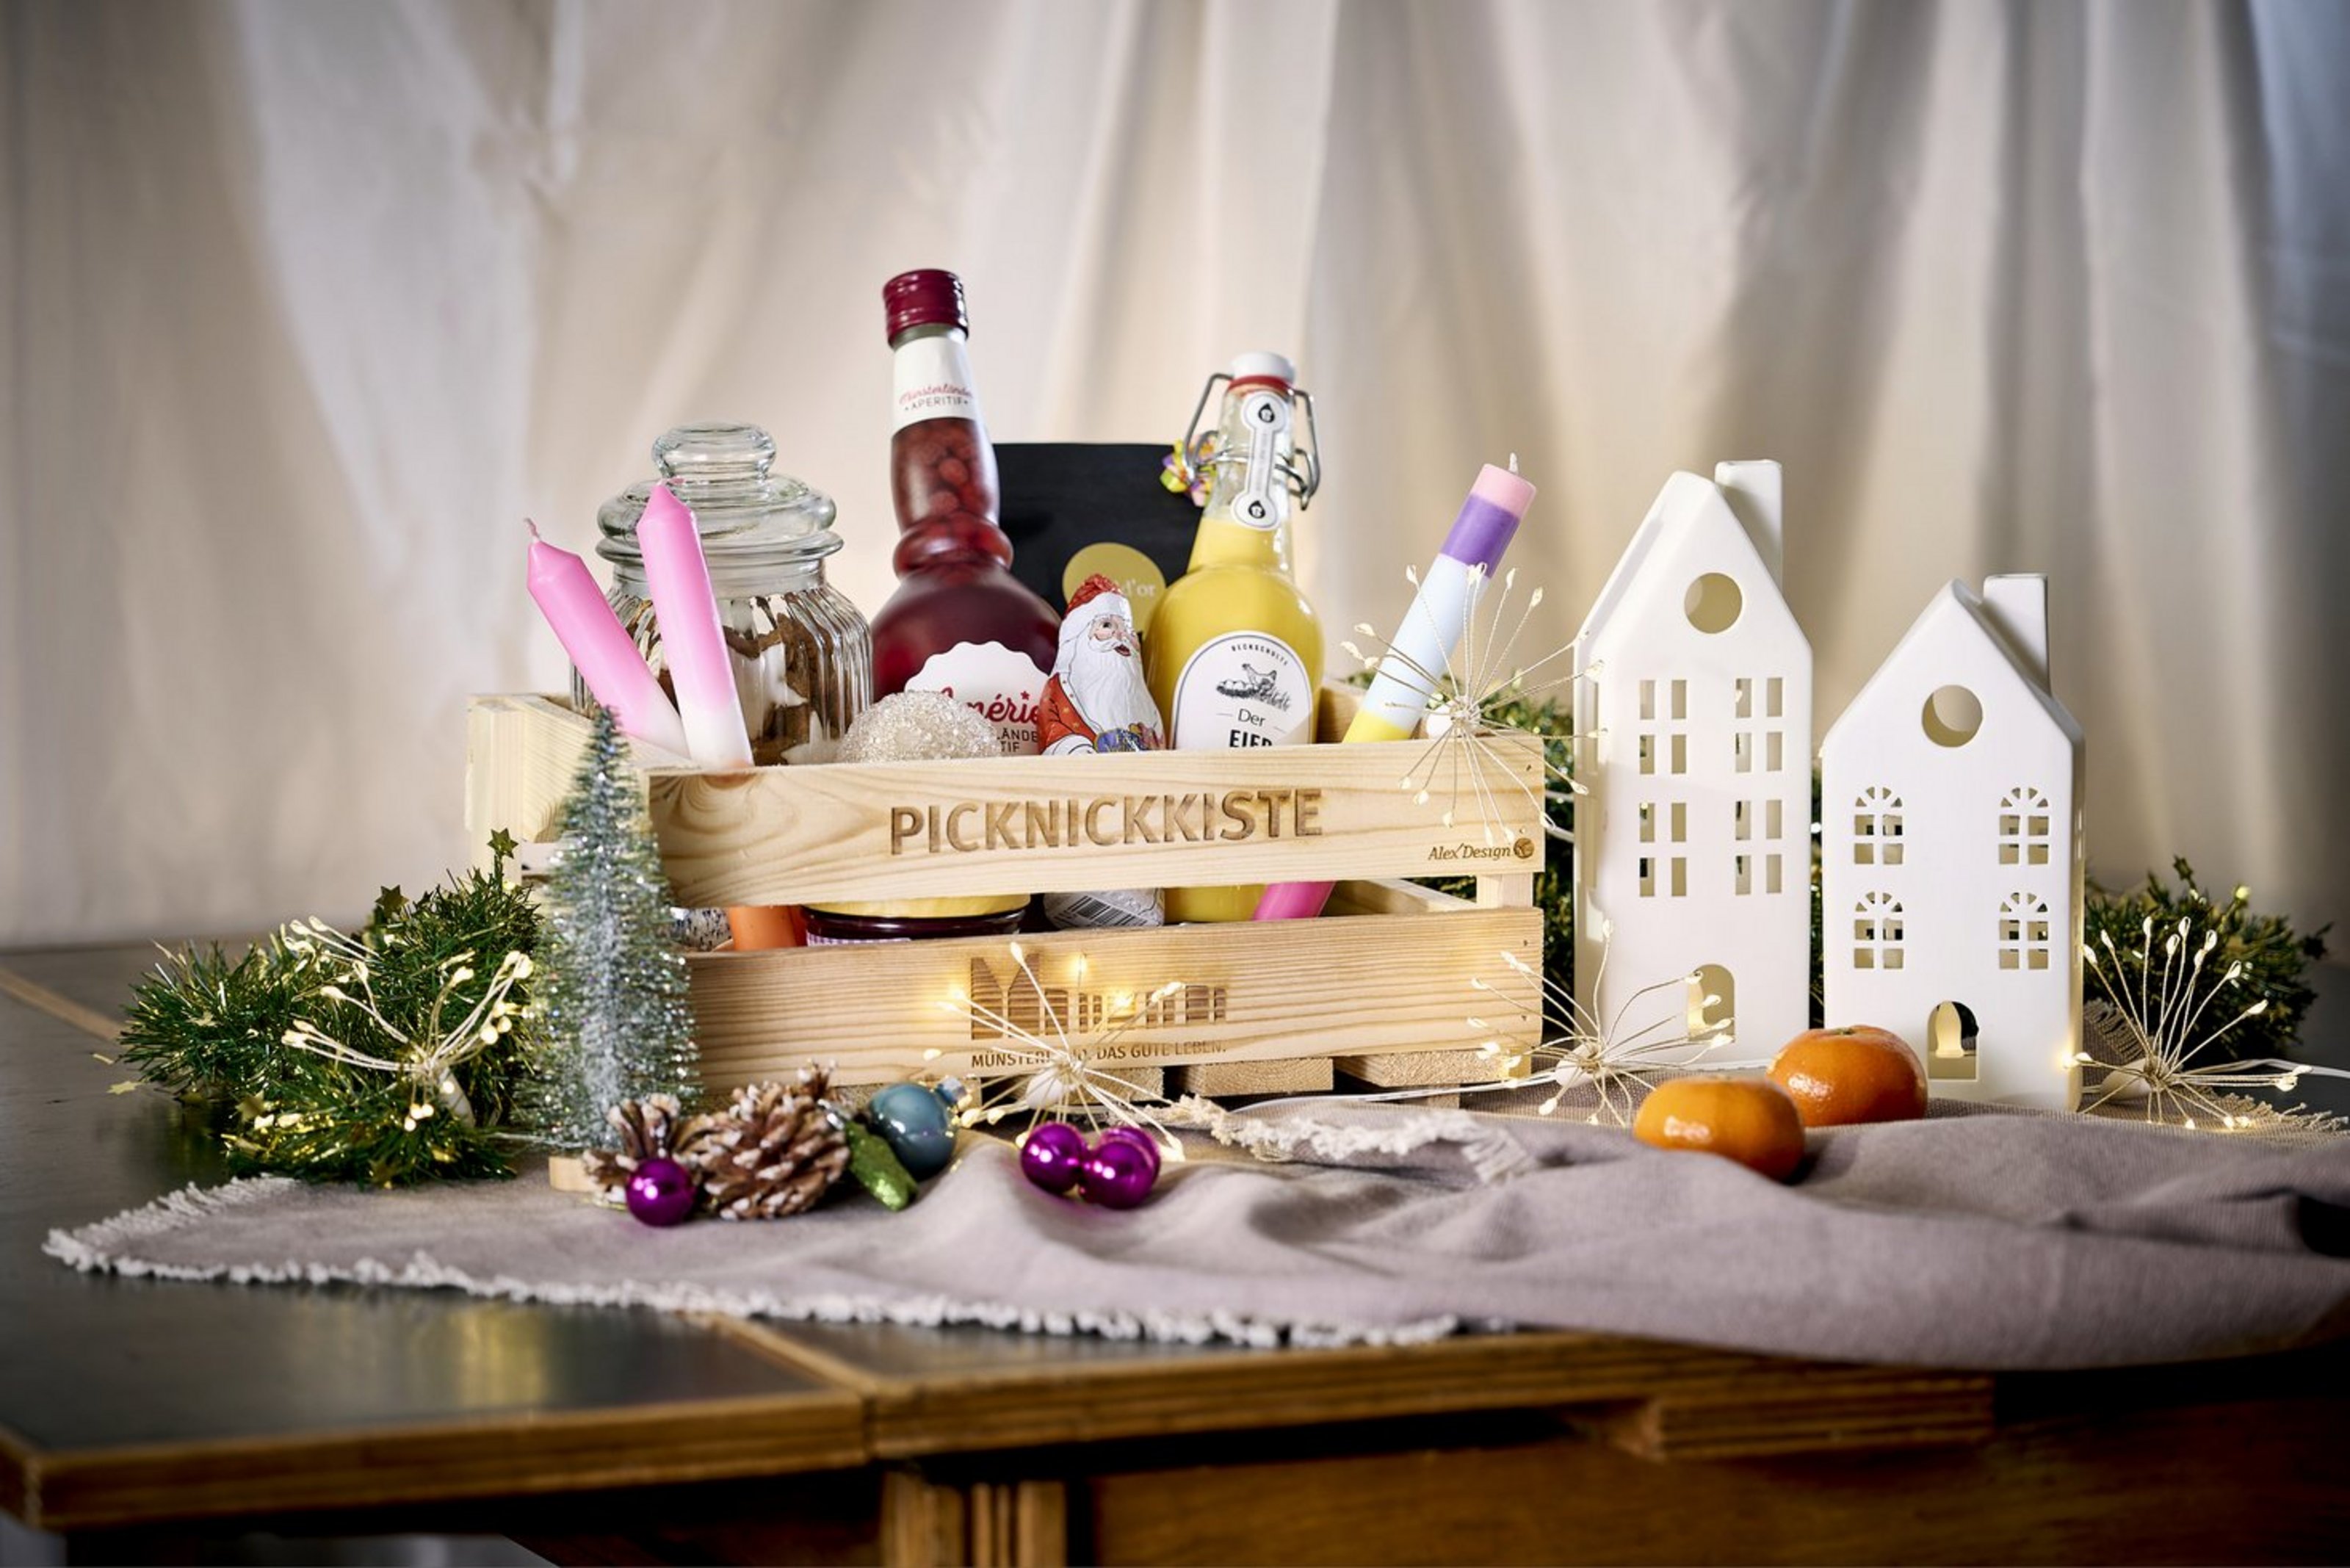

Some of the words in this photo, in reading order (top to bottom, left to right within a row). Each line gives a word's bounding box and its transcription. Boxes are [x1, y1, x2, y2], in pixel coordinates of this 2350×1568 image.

[1237, 708, 1266, 727] Der
[891, 789, 1323, 855] PICKNICKKISTE
[1097, 1045, 1127, 1060] DAS
[1130, 1042, 1170, 1058] GUTE
